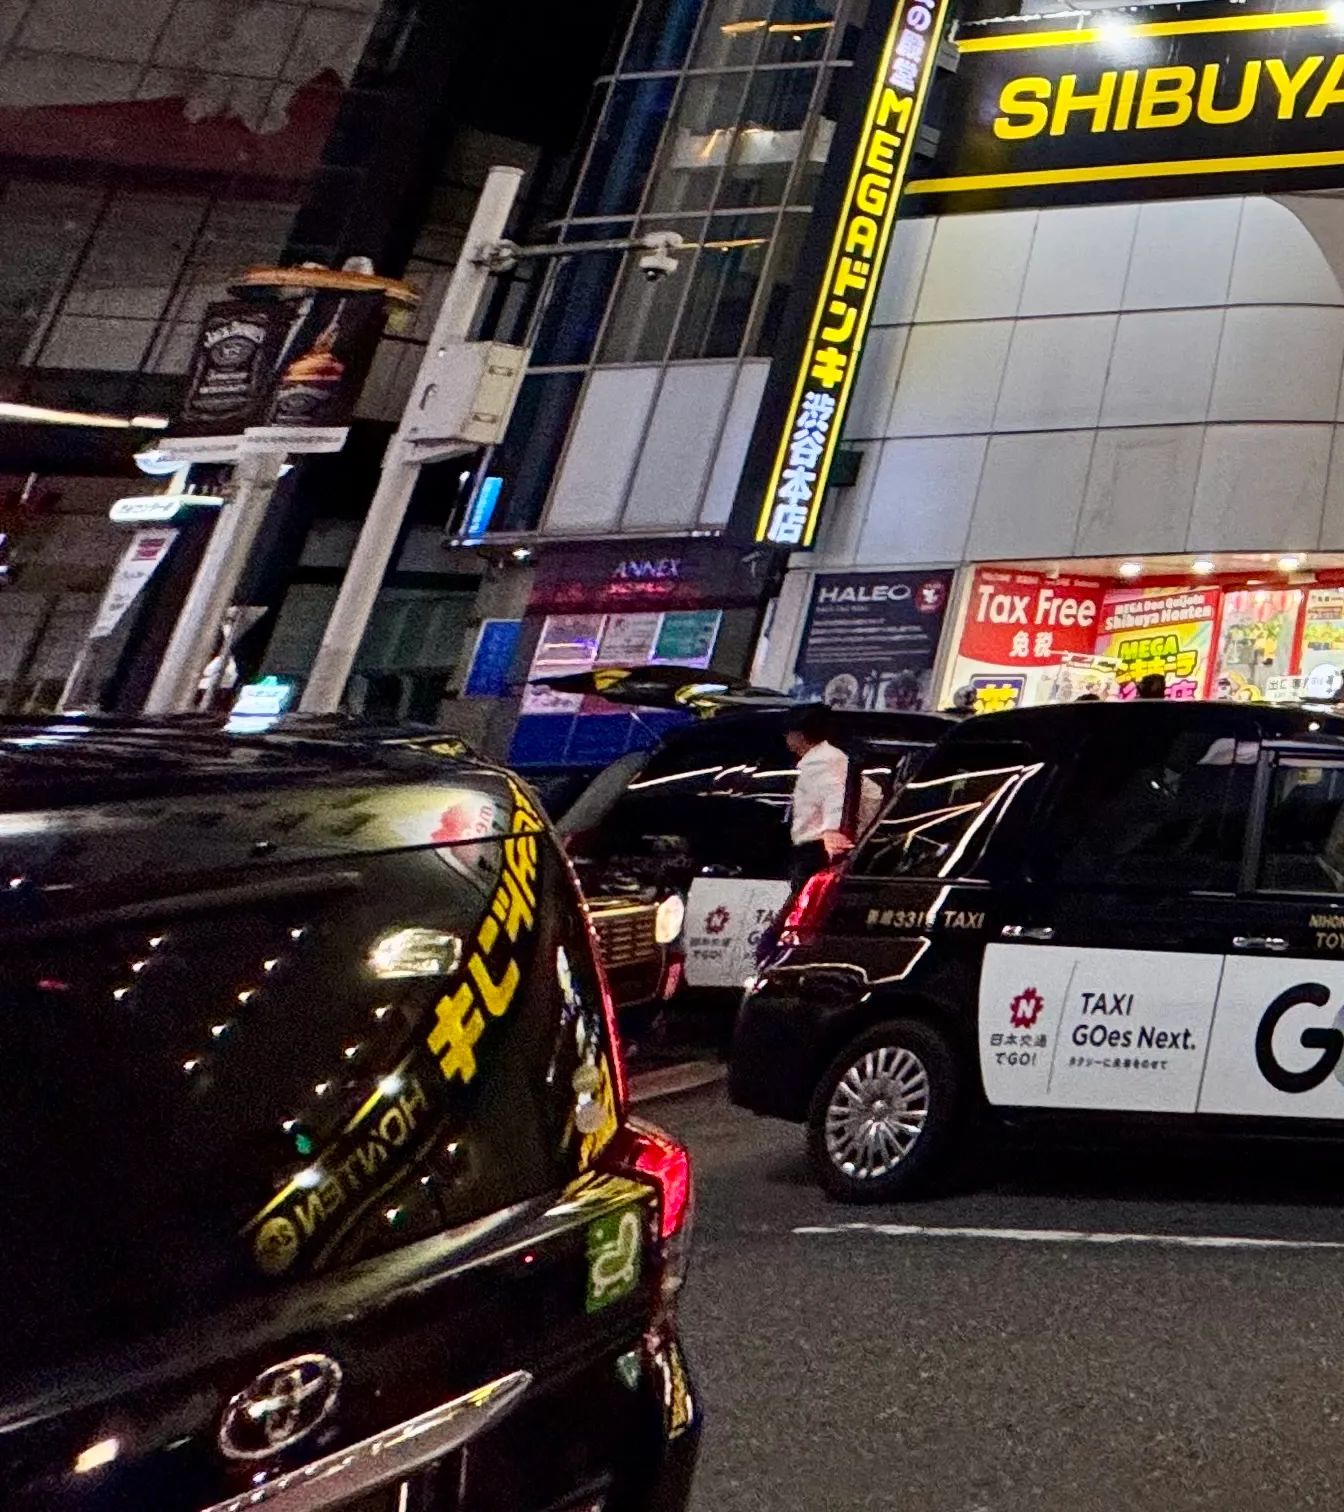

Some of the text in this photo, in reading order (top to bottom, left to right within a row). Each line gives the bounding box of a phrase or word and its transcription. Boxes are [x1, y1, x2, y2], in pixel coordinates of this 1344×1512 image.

[811, 87, 914, 389] MEGAドンキ
[767, 390, 836, 545] 渋谷本店
[818, 584, 912, 603] HALEO
[976, 584, 1097, 627] Tax Free
[1104, 604, 1212, 631] Shibuya Honten
[1009, 630, 1054, 658] 免税
[1120, 635, 1179, 659] MEGA
[943, 910, 986, 929] TAXI
[1081, 992, 1135, 1016] TAXI
[989, 1033, 1048, 1048] 日本交通
[1071, 1024, 1197, 1050] GOes Next.
[995, 1052, 1038, 1067] でGO!
